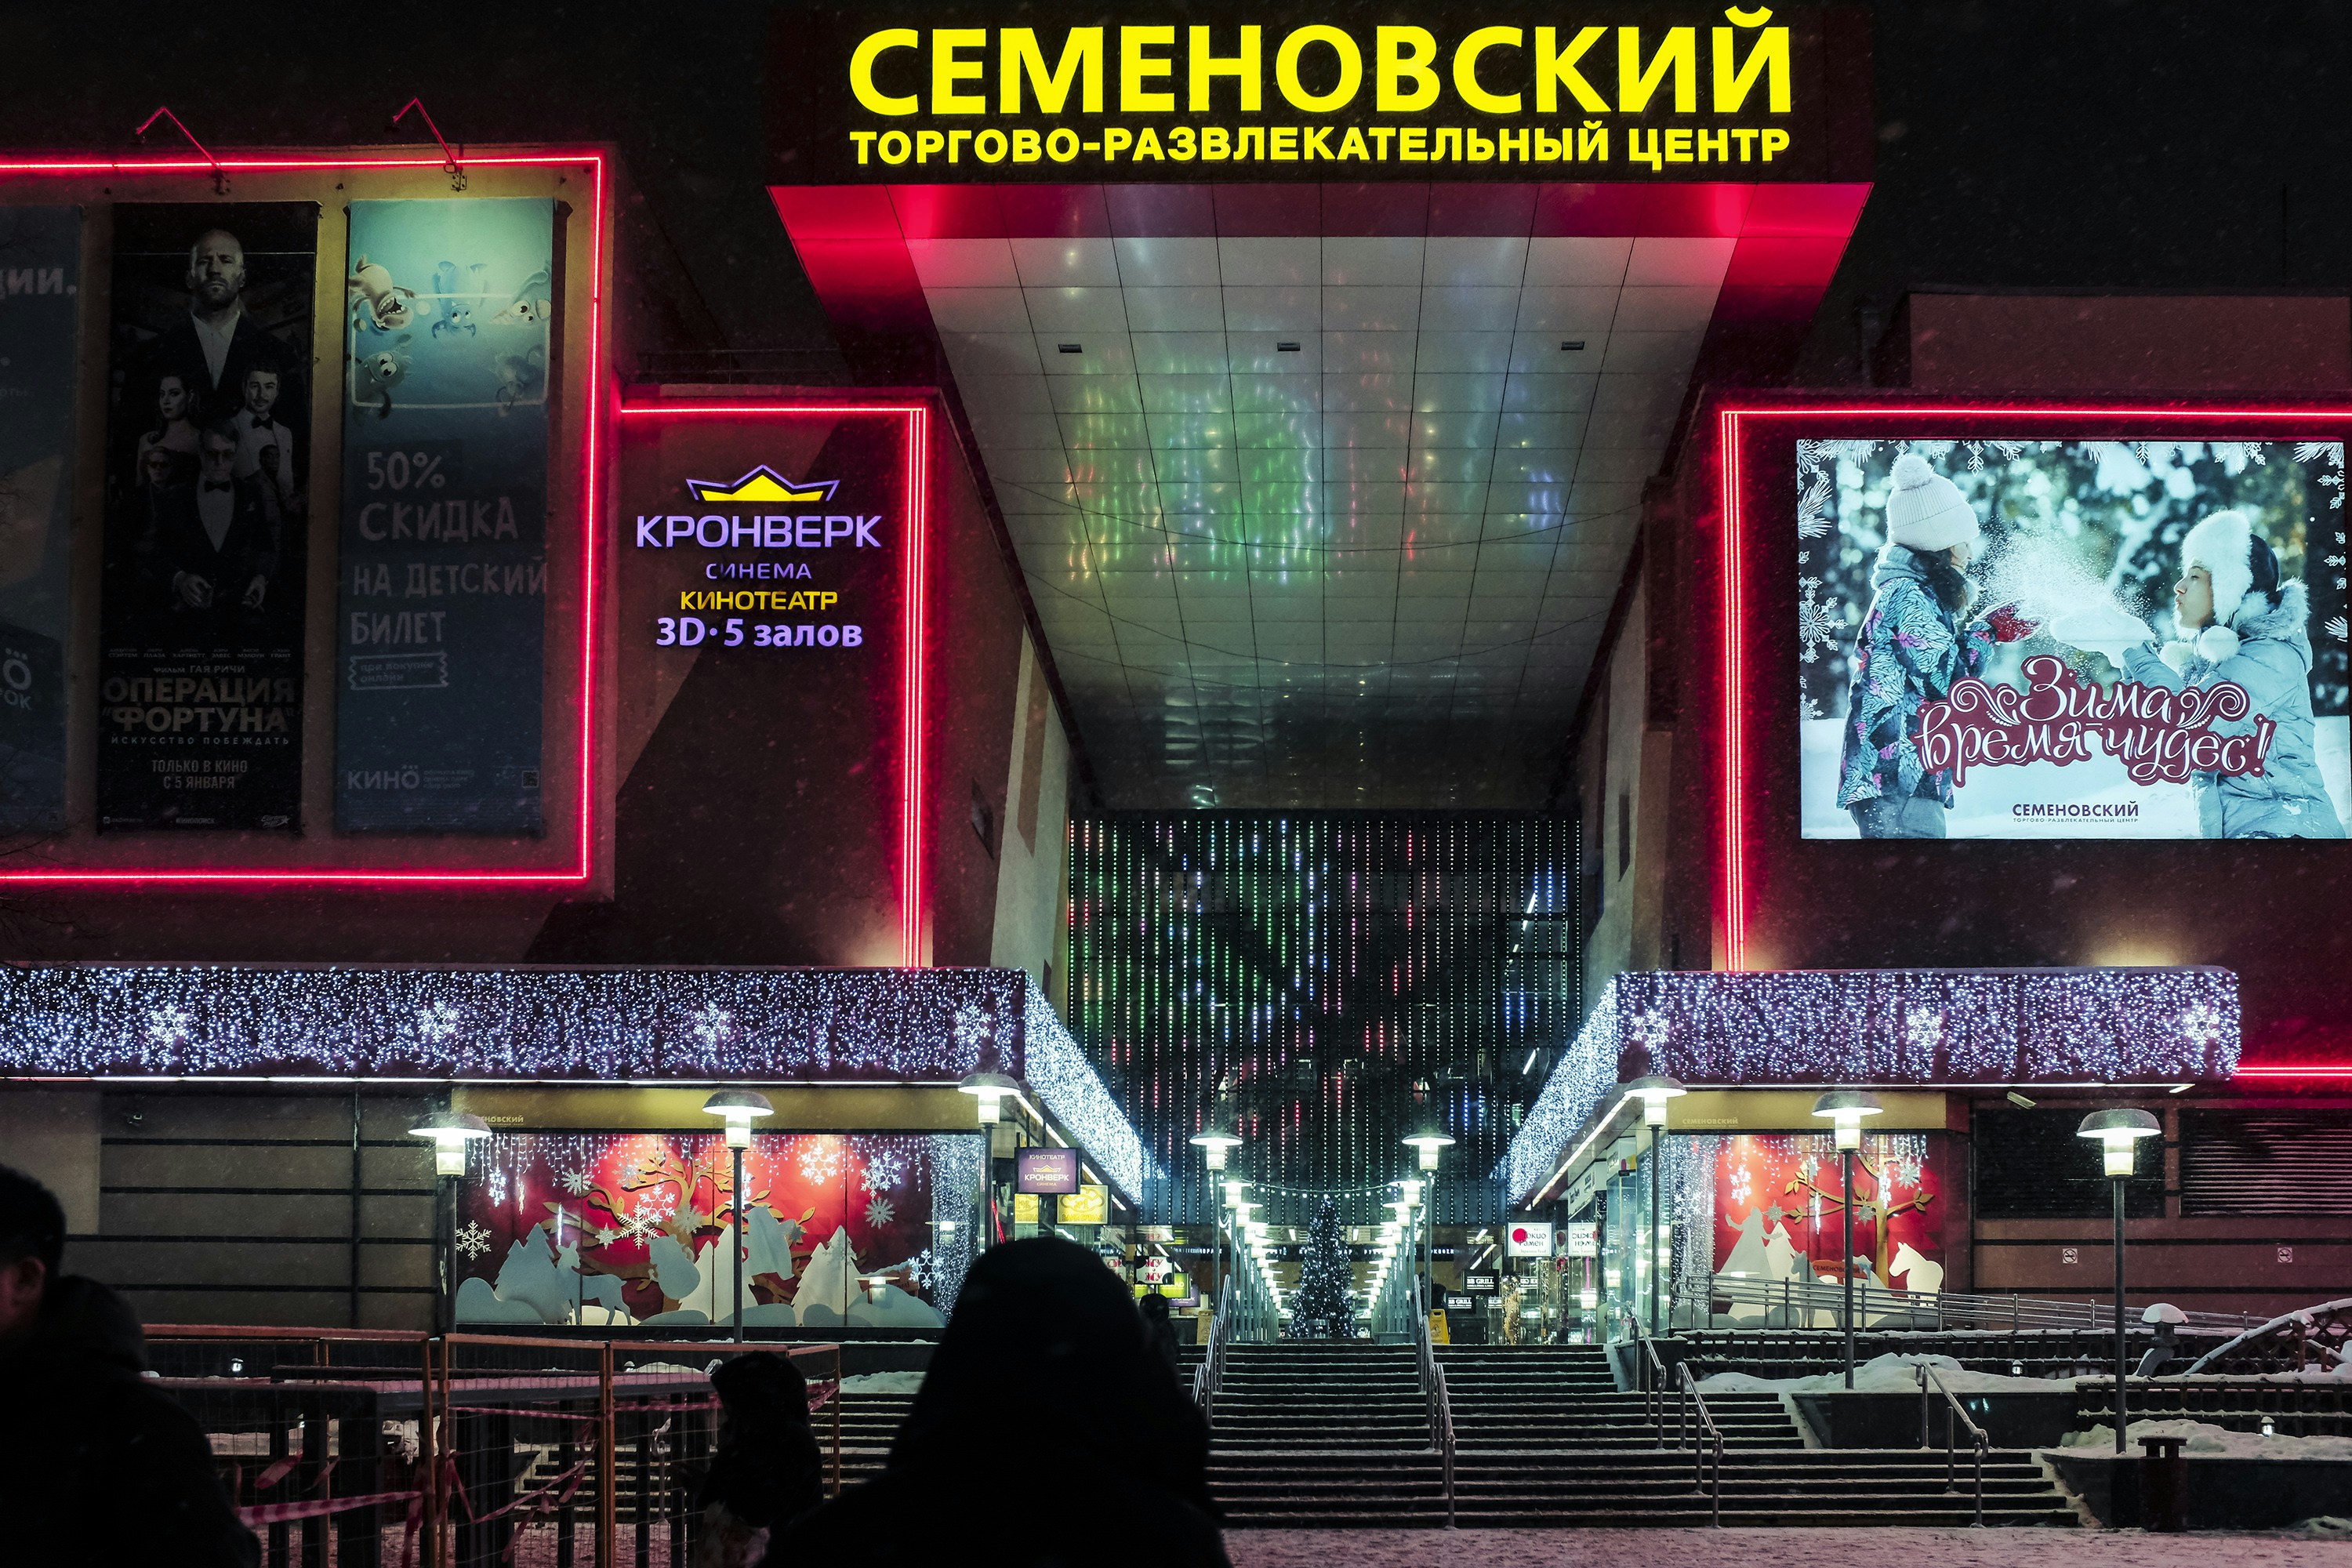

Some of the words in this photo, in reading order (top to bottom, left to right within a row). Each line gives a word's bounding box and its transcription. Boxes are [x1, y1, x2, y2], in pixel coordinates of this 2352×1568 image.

[849, 6, 1792, 117] СЕМЕНОВСКИЙ
[849, 122, 1609, 165] ТОРГОВО-РАЗВЛЕКАТЕЛЬНЫЙ
[1628, 128, 1791, 172] ЦЕНТР
[0, 268, 77, 300] ИИ.
[368, 452, 445, 489] 50%
[359, 497, 518, 542] СКИДКА
[637, 515, 882, 547] КРОНВЕРК
[354, 564, 392, 596] НА
[405, 555, 547, 597] ДЕТСКИЙ
[706, 563, 812, 579] СИНЕМА
[681, 591, 837, 610] КИНОТЕАТР
[350, 612, 445, 644] БИЛЕТ
[753, 625, 862, 647] залов
[190, 665, 211, 673] ГАЯ
[214, 665, 245, 673] РИЧИ
[103, 677, 296, 706] ОПЕРАЦИЯ
[2020, 656, 2171, 722] Зима
[203, 737, 289, 746] ПОБЕЖДАТЬ
[151, 760, 199, 773] ТОЛЬКО
[204, 760, 212, 773] В
[215, 760, 248, 773] КИНО
[163, 776, 171, 789] С
[175, 776, 182, 789] 5
[186, 776, 235, 789] ЯНВАРЯ
[2013, 800, 2139, 816] СЕМЕНОВСКИЙ
